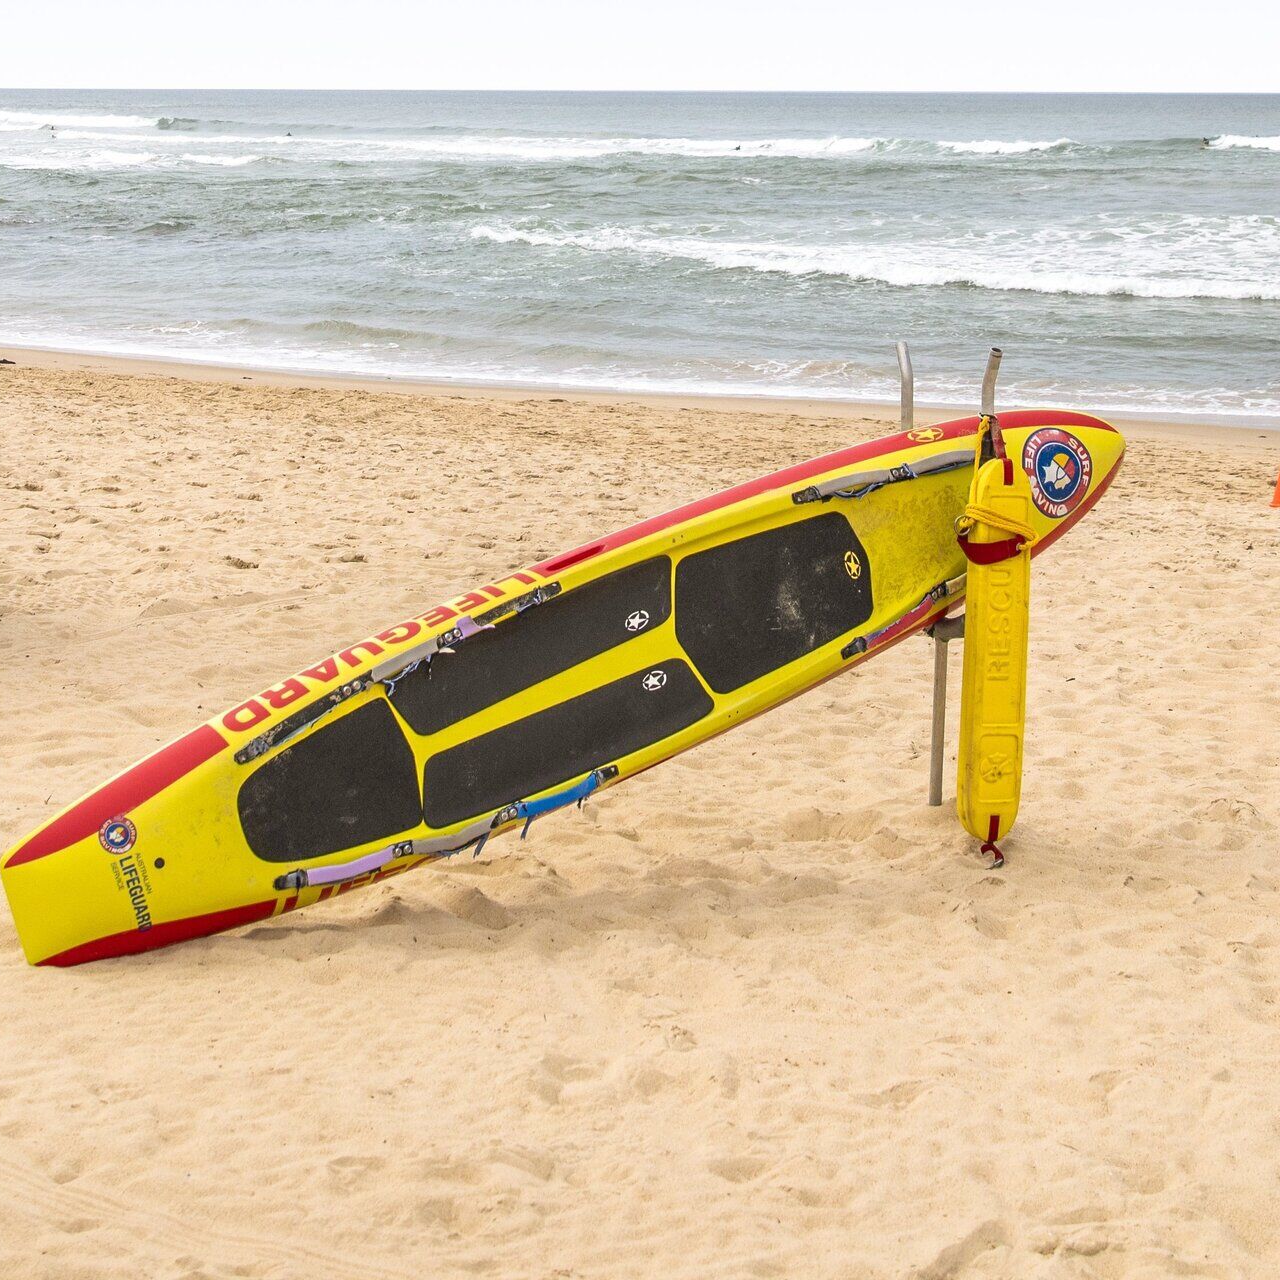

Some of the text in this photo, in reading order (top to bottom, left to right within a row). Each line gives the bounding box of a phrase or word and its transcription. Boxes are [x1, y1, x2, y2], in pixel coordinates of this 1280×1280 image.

[1024, 434, 1042, 470] LIFE
[1067, 437, 1090, 486] SURF
[222, 572, 538, 733] LIFEGUARD
[986, 565, 1013, 681] RESCU
[119, 855, 153, 933] LIFEGUARD
[135, 852, 153, 895] AUSTRALIAN
